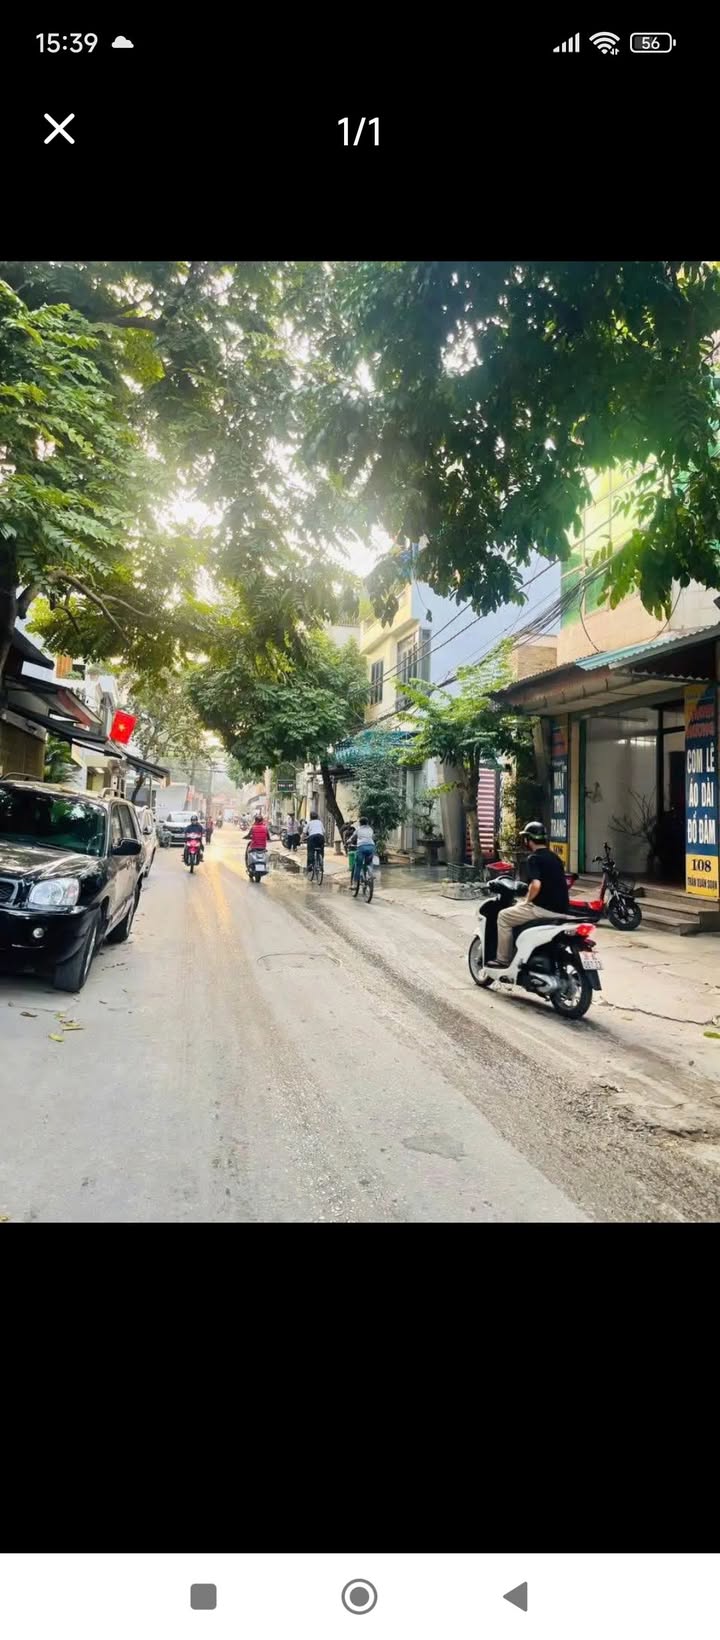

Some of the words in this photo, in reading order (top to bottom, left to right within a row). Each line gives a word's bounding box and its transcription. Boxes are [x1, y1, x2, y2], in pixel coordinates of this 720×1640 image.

[706, 742, 715, 773] LÊ
[688, 777, 699, 807] ÁO
[701, 776, 714, 807] DÀI
[691, 858, 712, 873] 108
